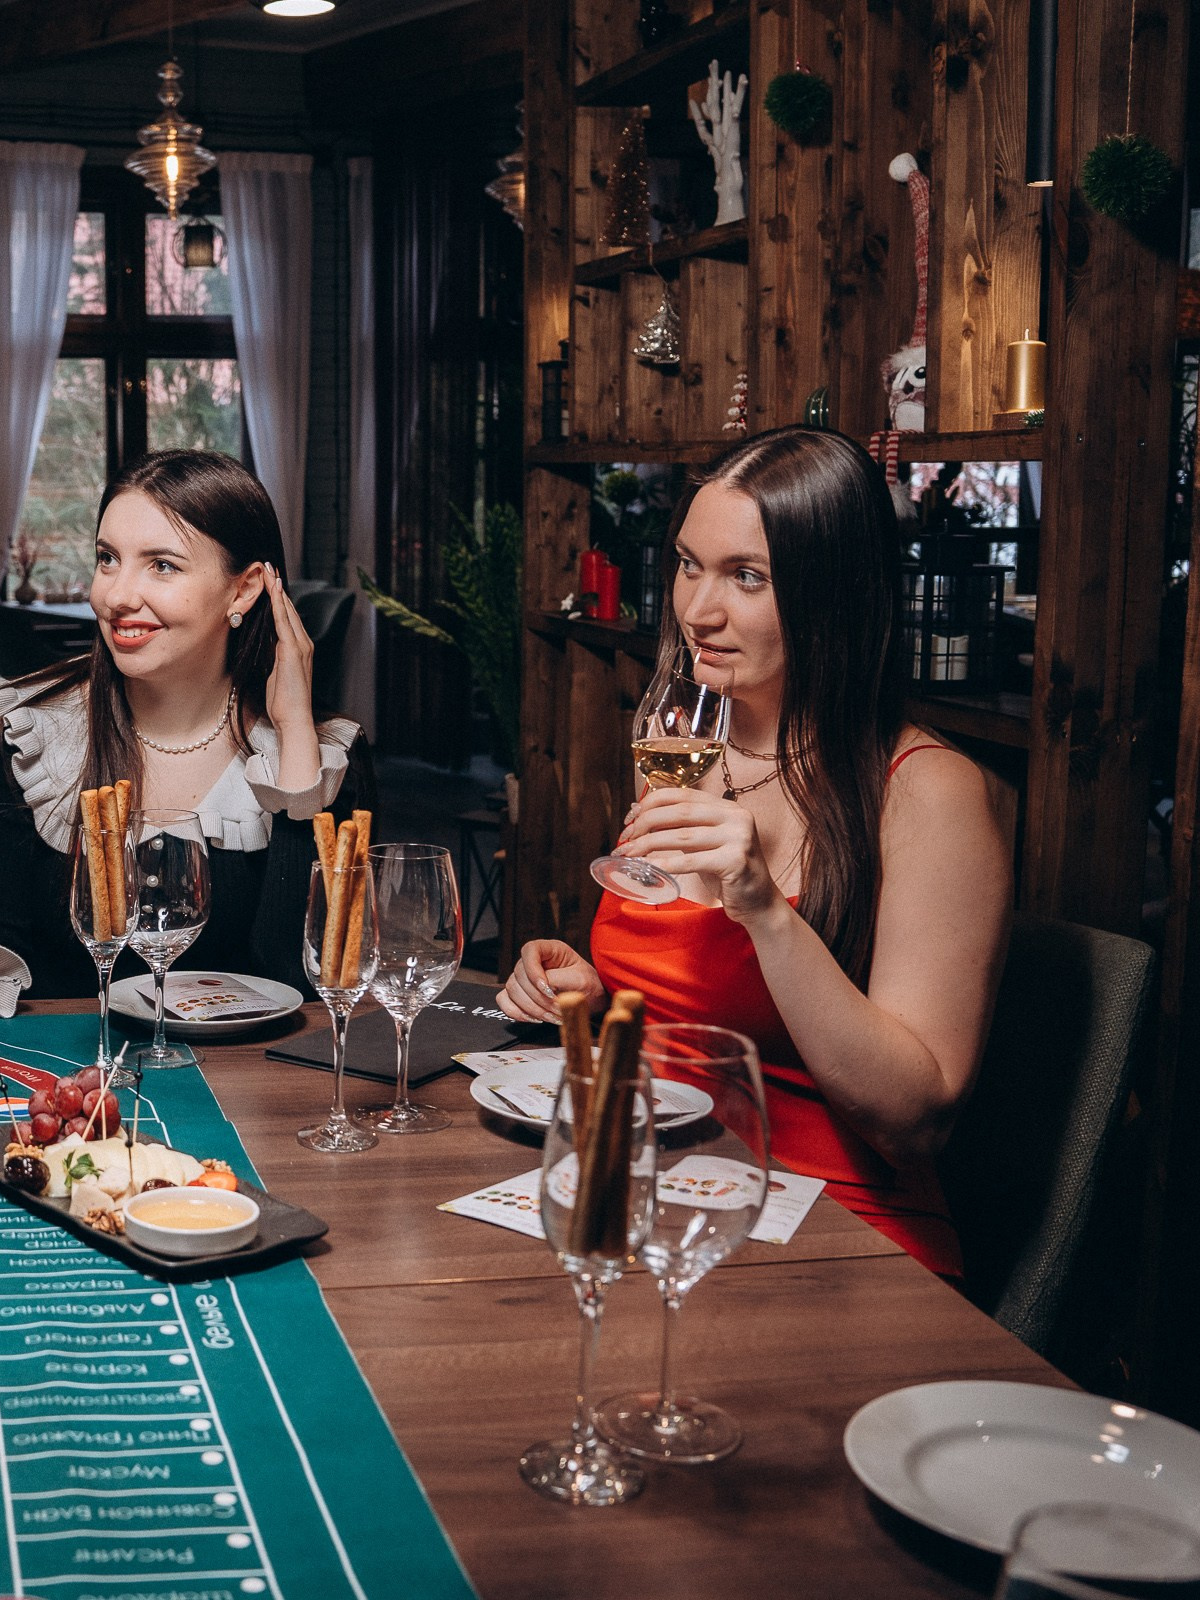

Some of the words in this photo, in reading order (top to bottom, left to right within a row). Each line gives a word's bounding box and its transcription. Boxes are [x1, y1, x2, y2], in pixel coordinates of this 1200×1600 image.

[24, 1279, 125, 1291] Вердехо
[0, 1302, 146, 1318] Альбариньо
[194, 1294, 236, 1350] белые
[24, 1332, 153, 1346] Гарганега
[45, 1361, 148, 1376] Кортезе
[139, 1429, 211, 1443] Пино
[67, 1463, 171, 1480] Мускат
[23, 1504, 92, 1523] Блан
[98, 1502, 236, 1520] Совиньон
[73, 1547, 196, 1565] Рислинг
